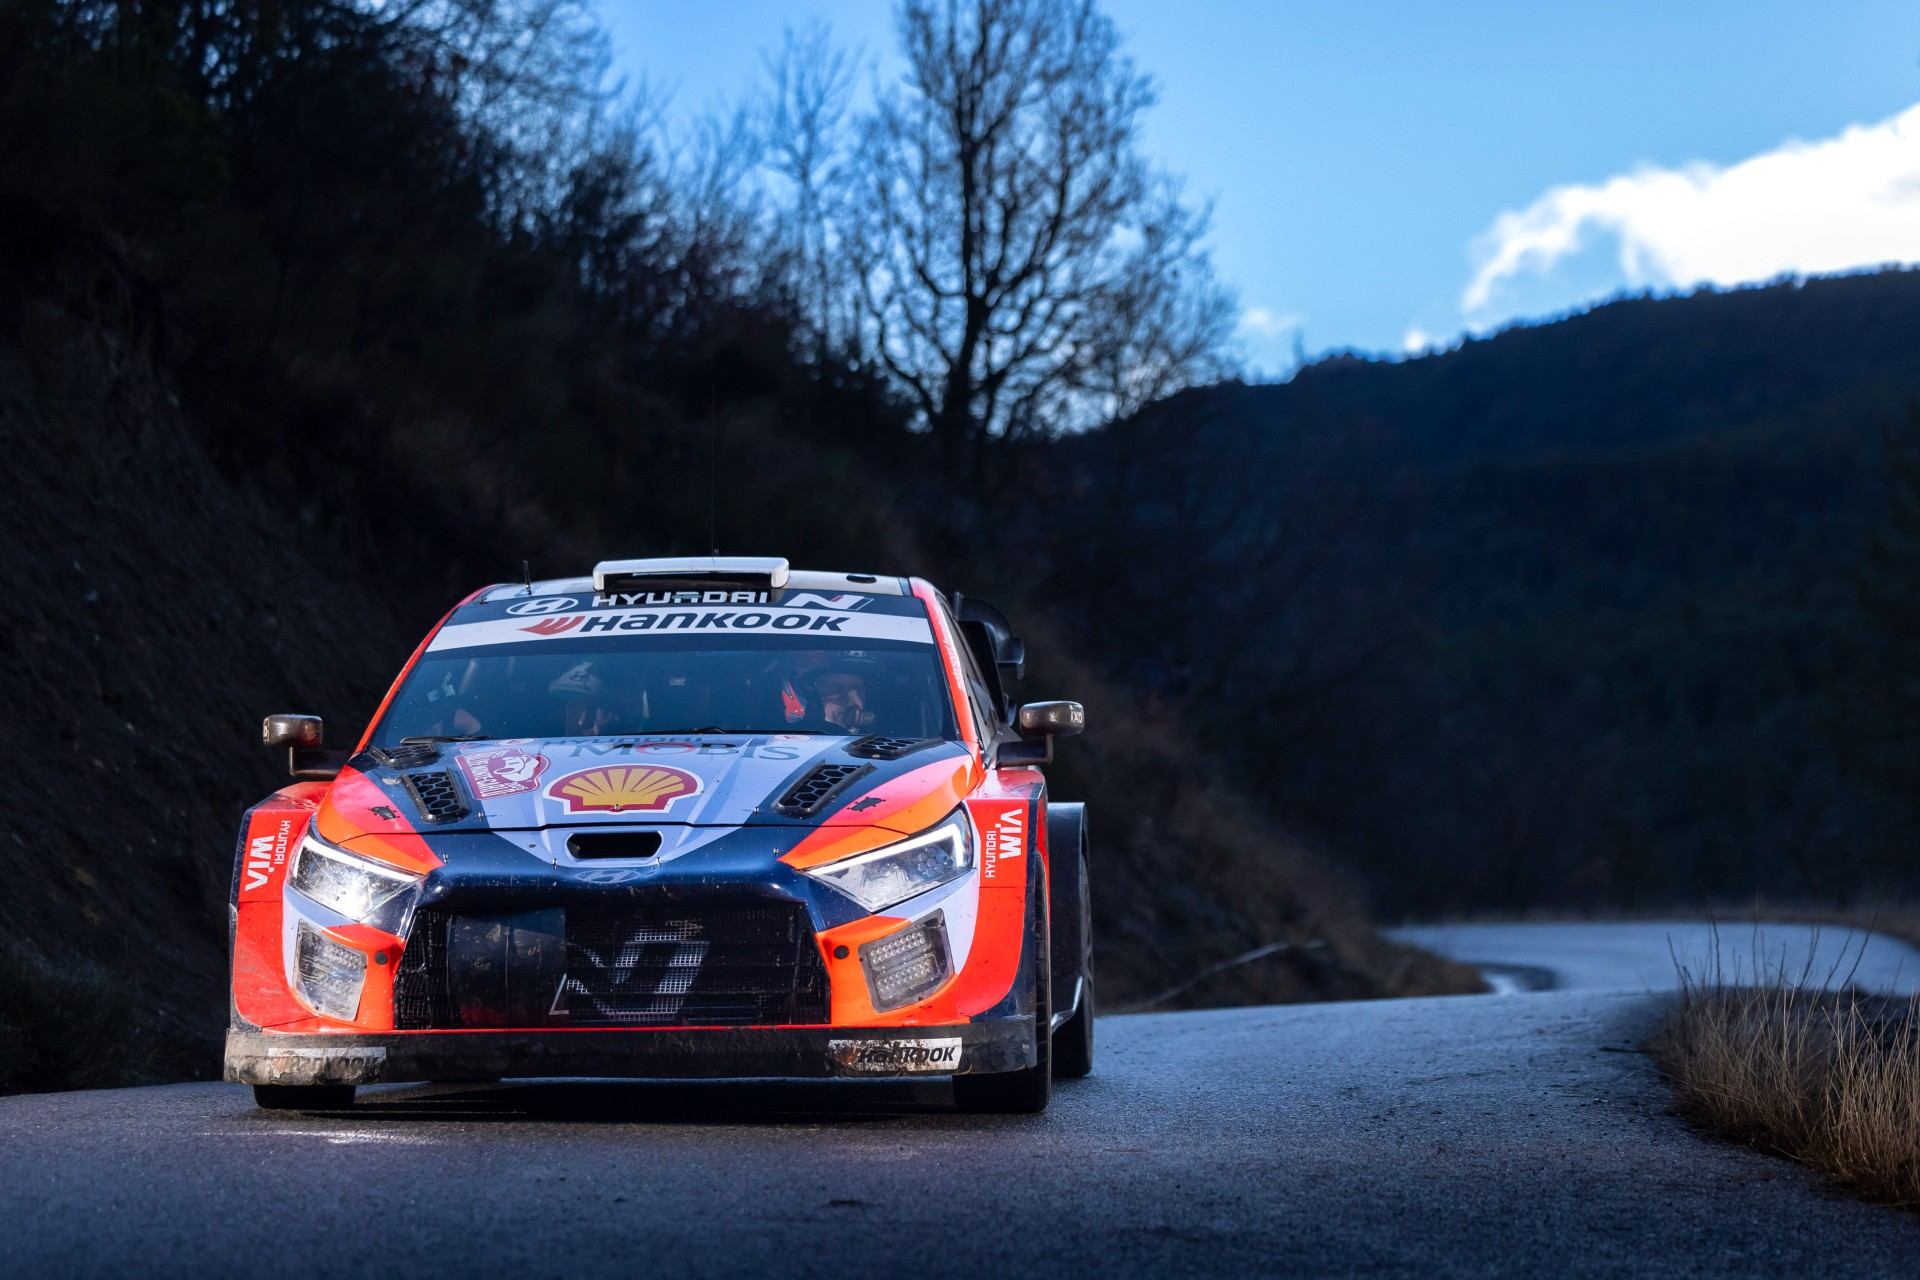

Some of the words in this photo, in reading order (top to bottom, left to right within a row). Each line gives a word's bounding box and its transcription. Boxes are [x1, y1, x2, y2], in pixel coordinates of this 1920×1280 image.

[591, 591, 768, 607] HYUNDAI
[579, 612, 851, 632] HANKOOK
[568, 742, 800, 761] MOBIS
[274, 820, 291, 865] HYUNDAI
[985, 830, 997, 878] HYUNDAI
[995, 808, 1023, 860] WIA
[244, 835, 276, 892] WIA
